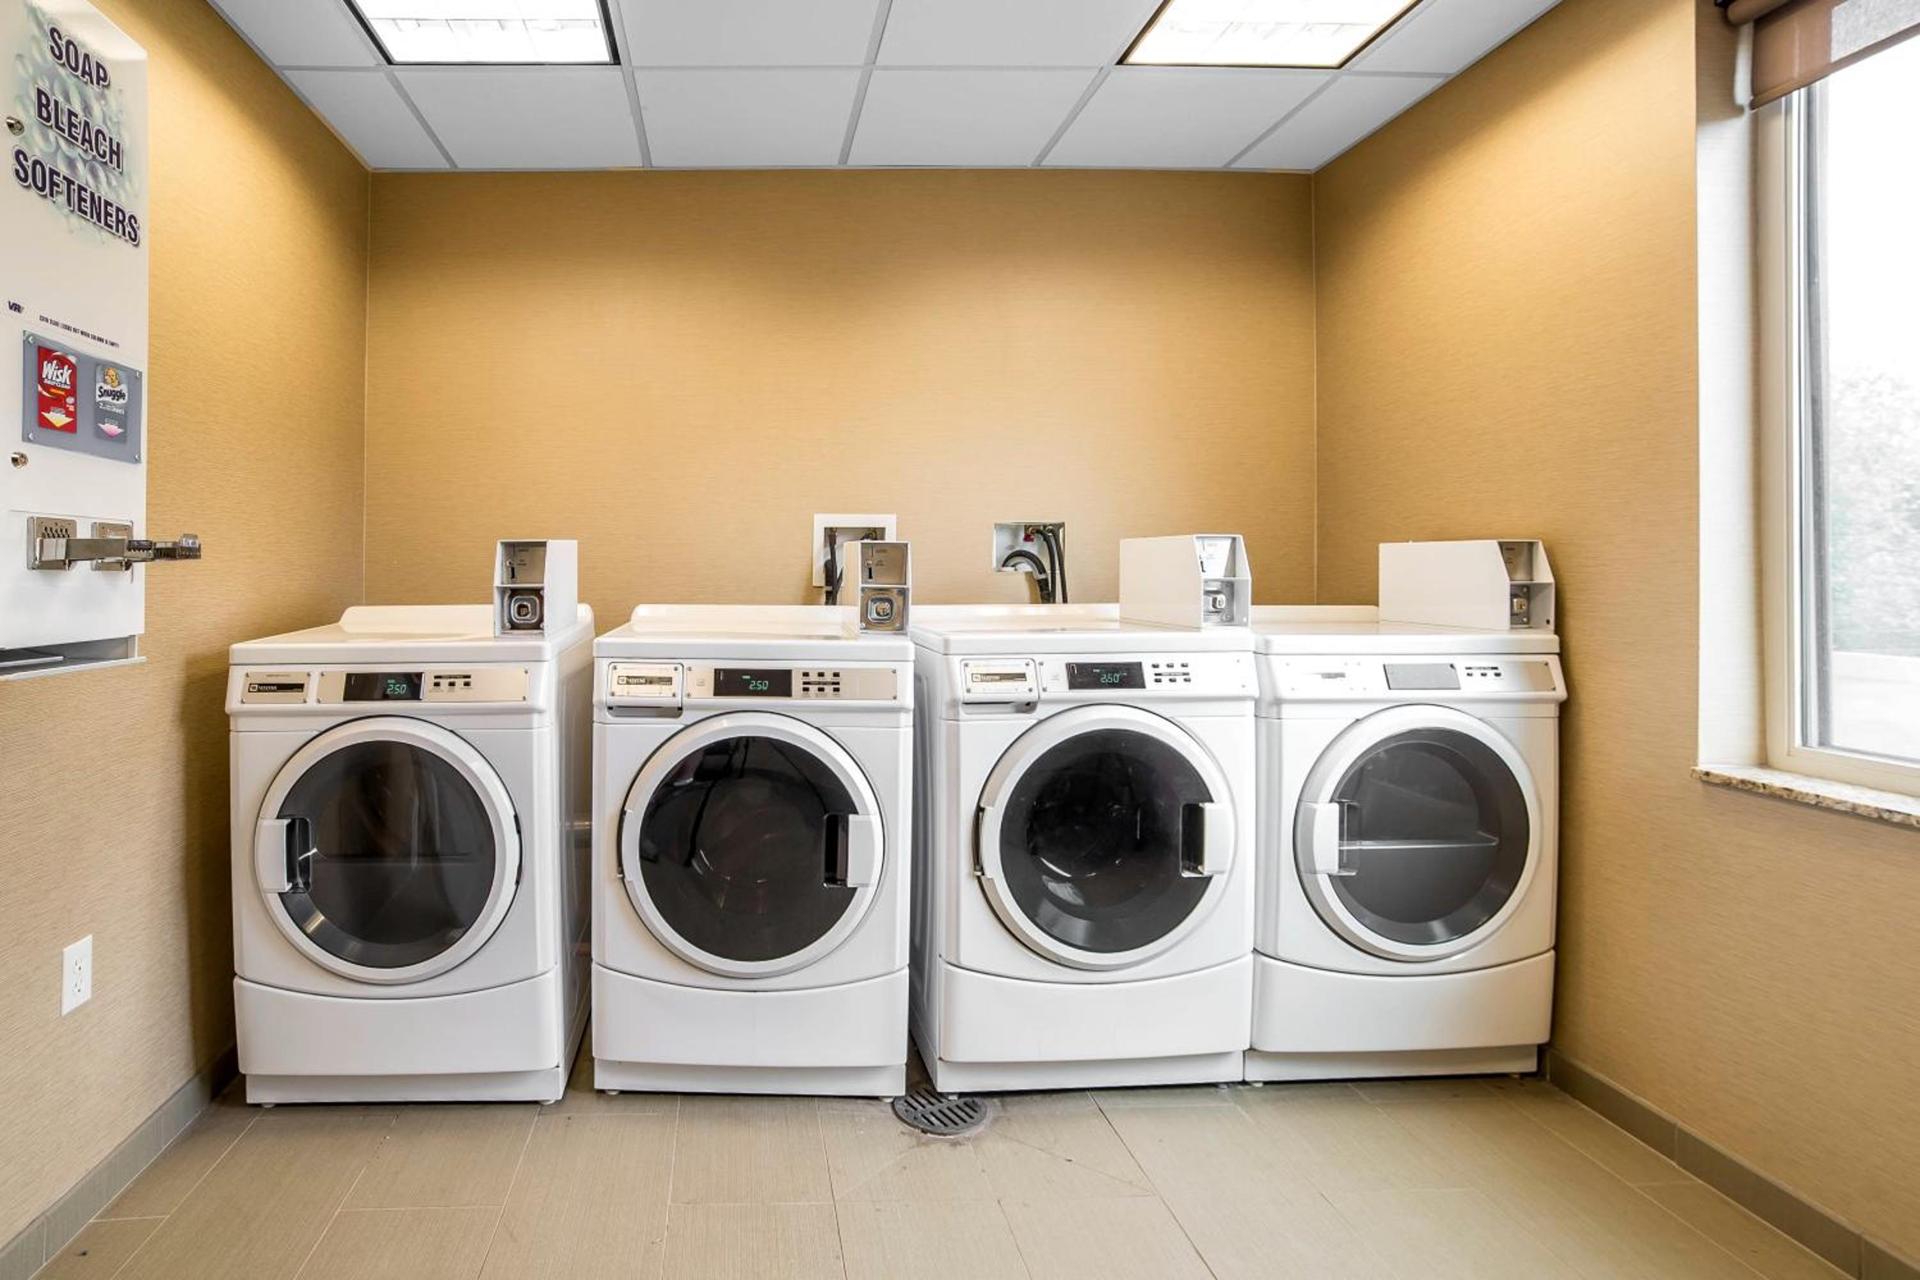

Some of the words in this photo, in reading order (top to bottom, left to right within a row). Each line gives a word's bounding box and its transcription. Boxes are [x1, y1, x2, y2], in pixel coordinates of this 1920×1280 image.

[49, 26, 110, 88] SOAP
[36, 87, 124, 171] BLEACH
[14, 149, 140, 245] SOFTENERS
[42, 359, 72, 384] Wisk
